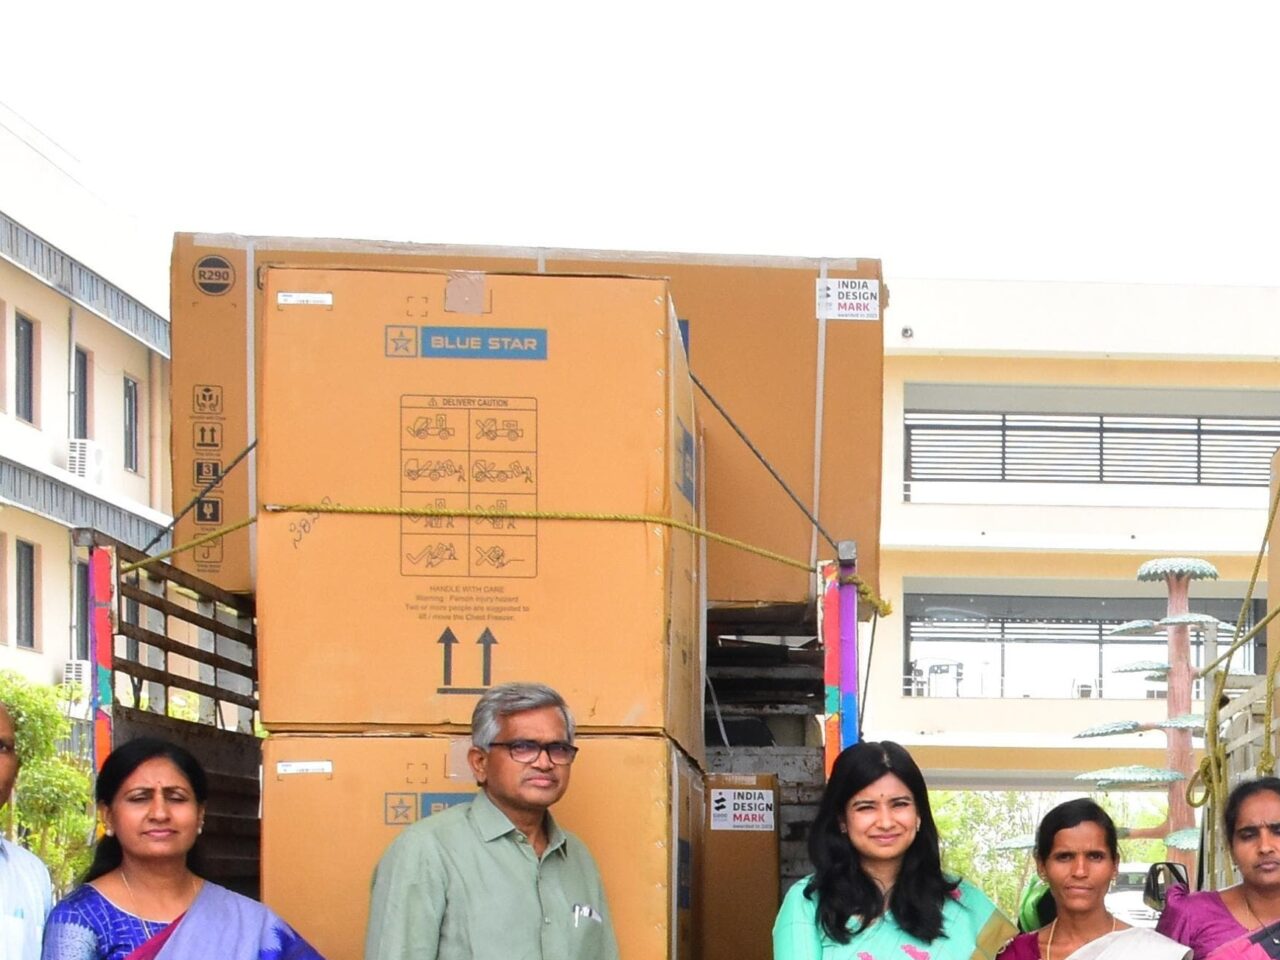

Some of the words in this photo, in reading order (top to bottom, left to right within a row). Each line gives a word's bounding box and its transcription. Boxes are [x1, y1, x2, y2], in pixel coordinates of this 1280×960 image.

[198, 270, 229, 281] R290
[837, 280, 869, 290] INDIA
[837, 291, 878, 301] DESIGN
[837, 302, 870, 312] MARK
[430, 335, 482, 350] BLUE
[488, 337, 538, 351] STAR
[442, 398, 476, 407] DELIVERY
[477, 398, 508, 407] CAUTION
[203, 463, 212, 476] 3
[733, 791, 765, 801] INDIA
[733, 802, 773, 812] DESIGN
[733, 813, 765, 822] MARK
